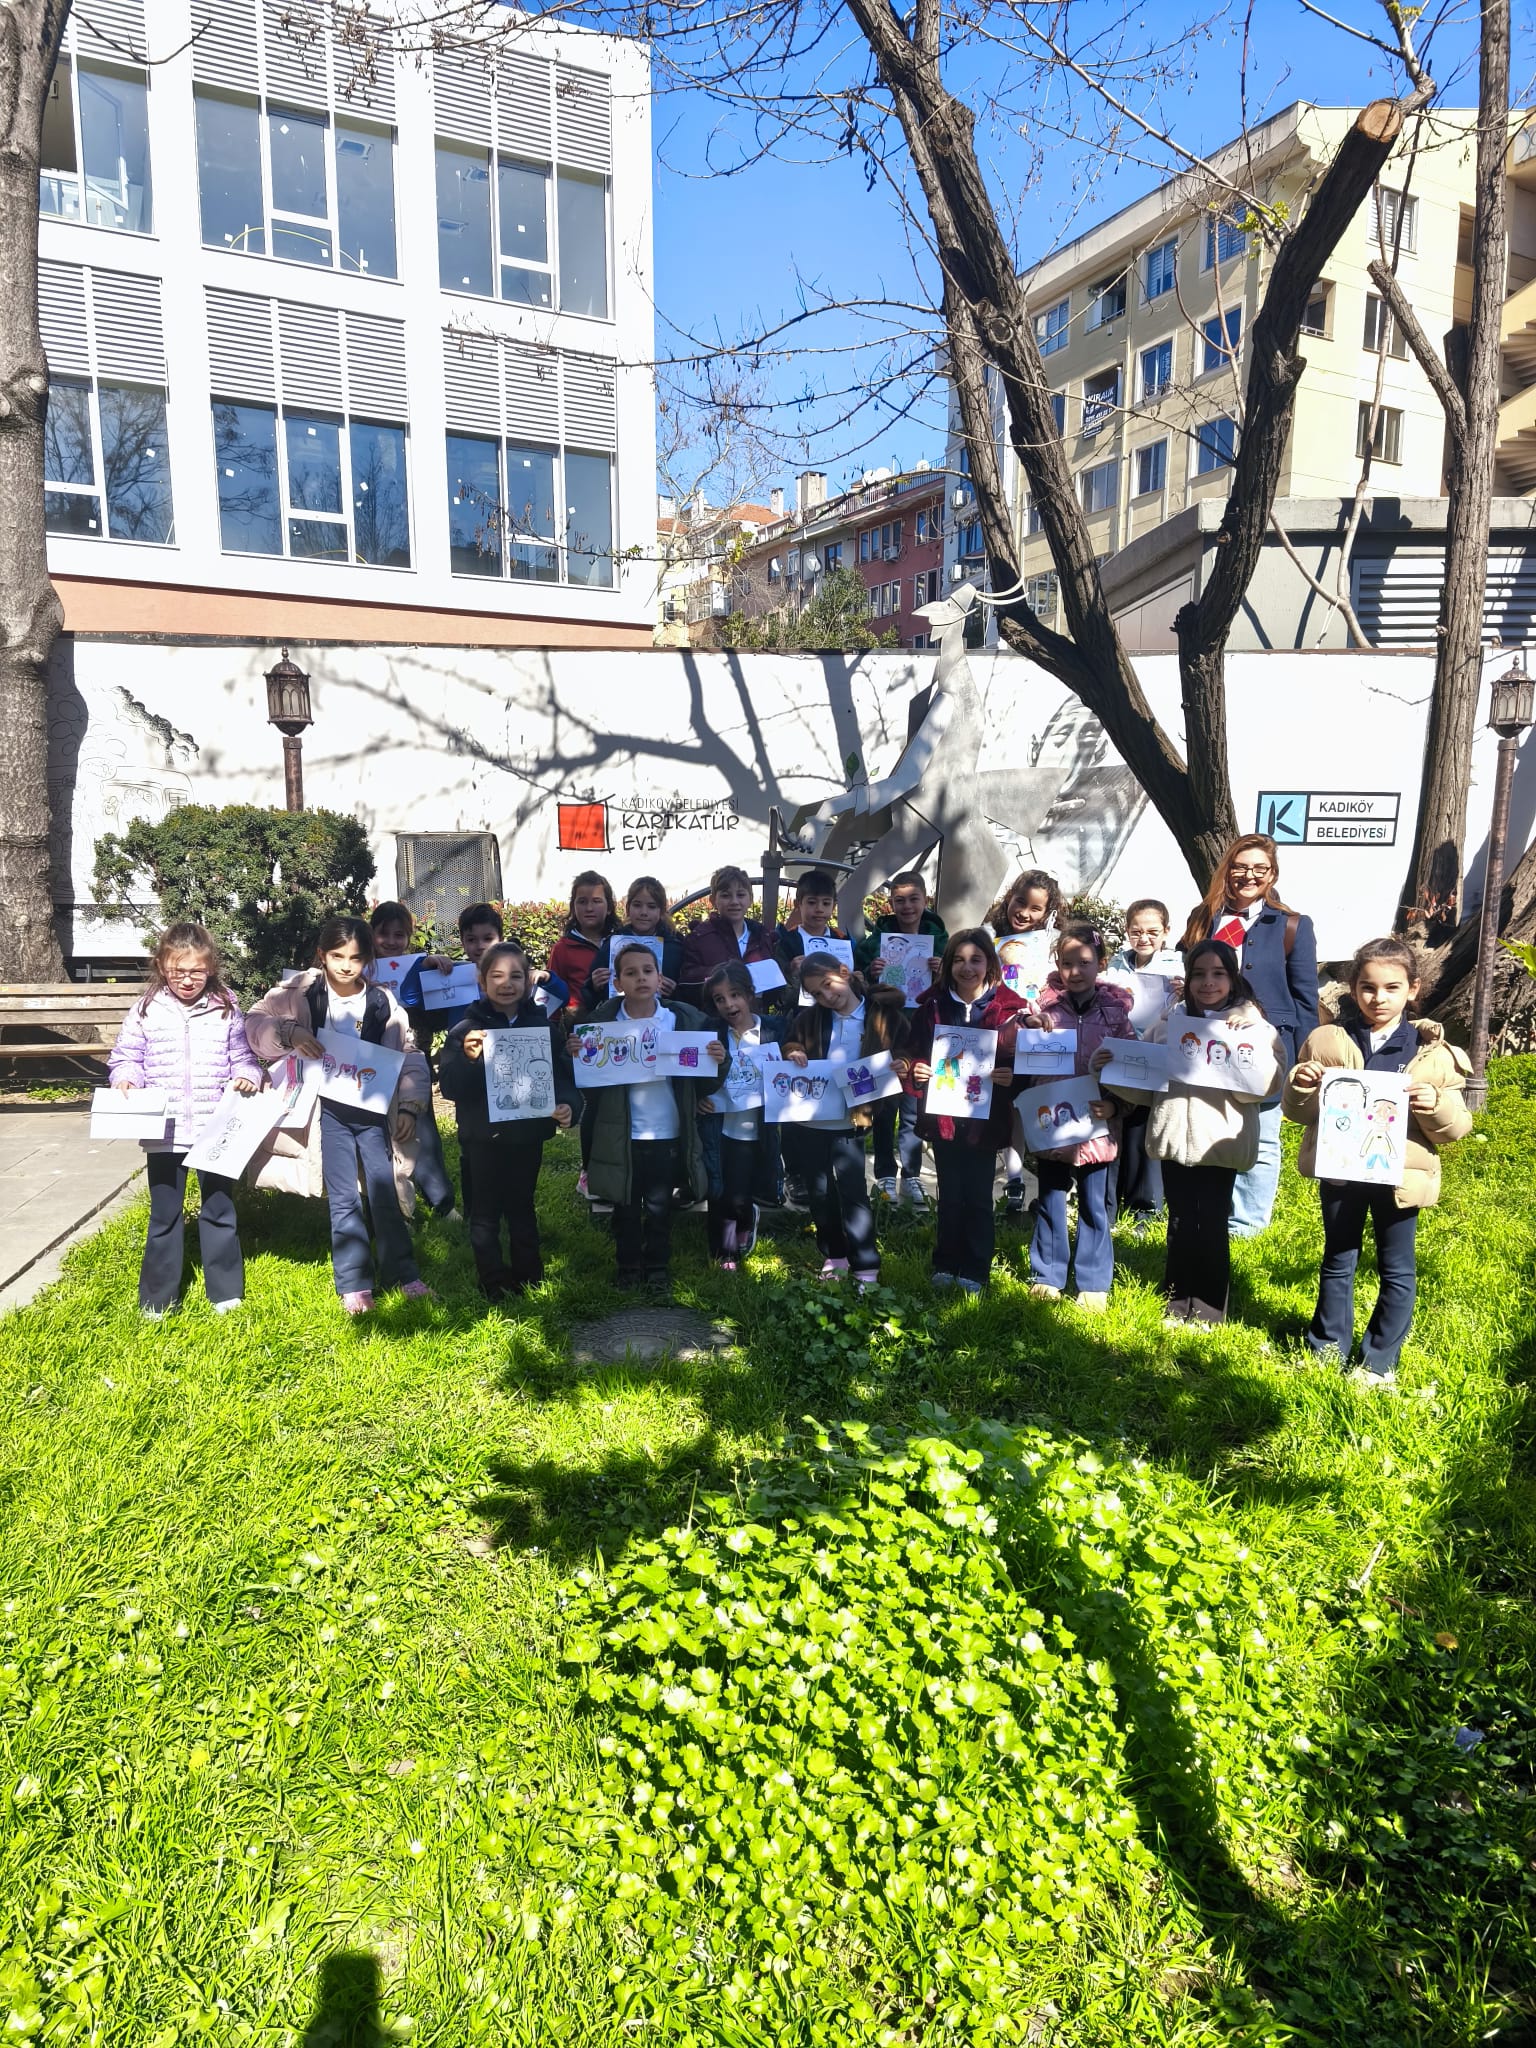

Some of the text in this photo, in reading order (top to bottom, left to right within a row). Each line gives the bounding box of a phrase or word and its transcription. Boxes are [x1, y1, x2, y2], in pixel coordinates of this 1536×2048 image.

[1319, 799, 1374, 813] KADIKÖY
[622, 810, 740, 830] KARİKATÜR
[1317, 824, 1387, 838] BELEDİYESİ
[622, 832, 658, 851] EVİ
